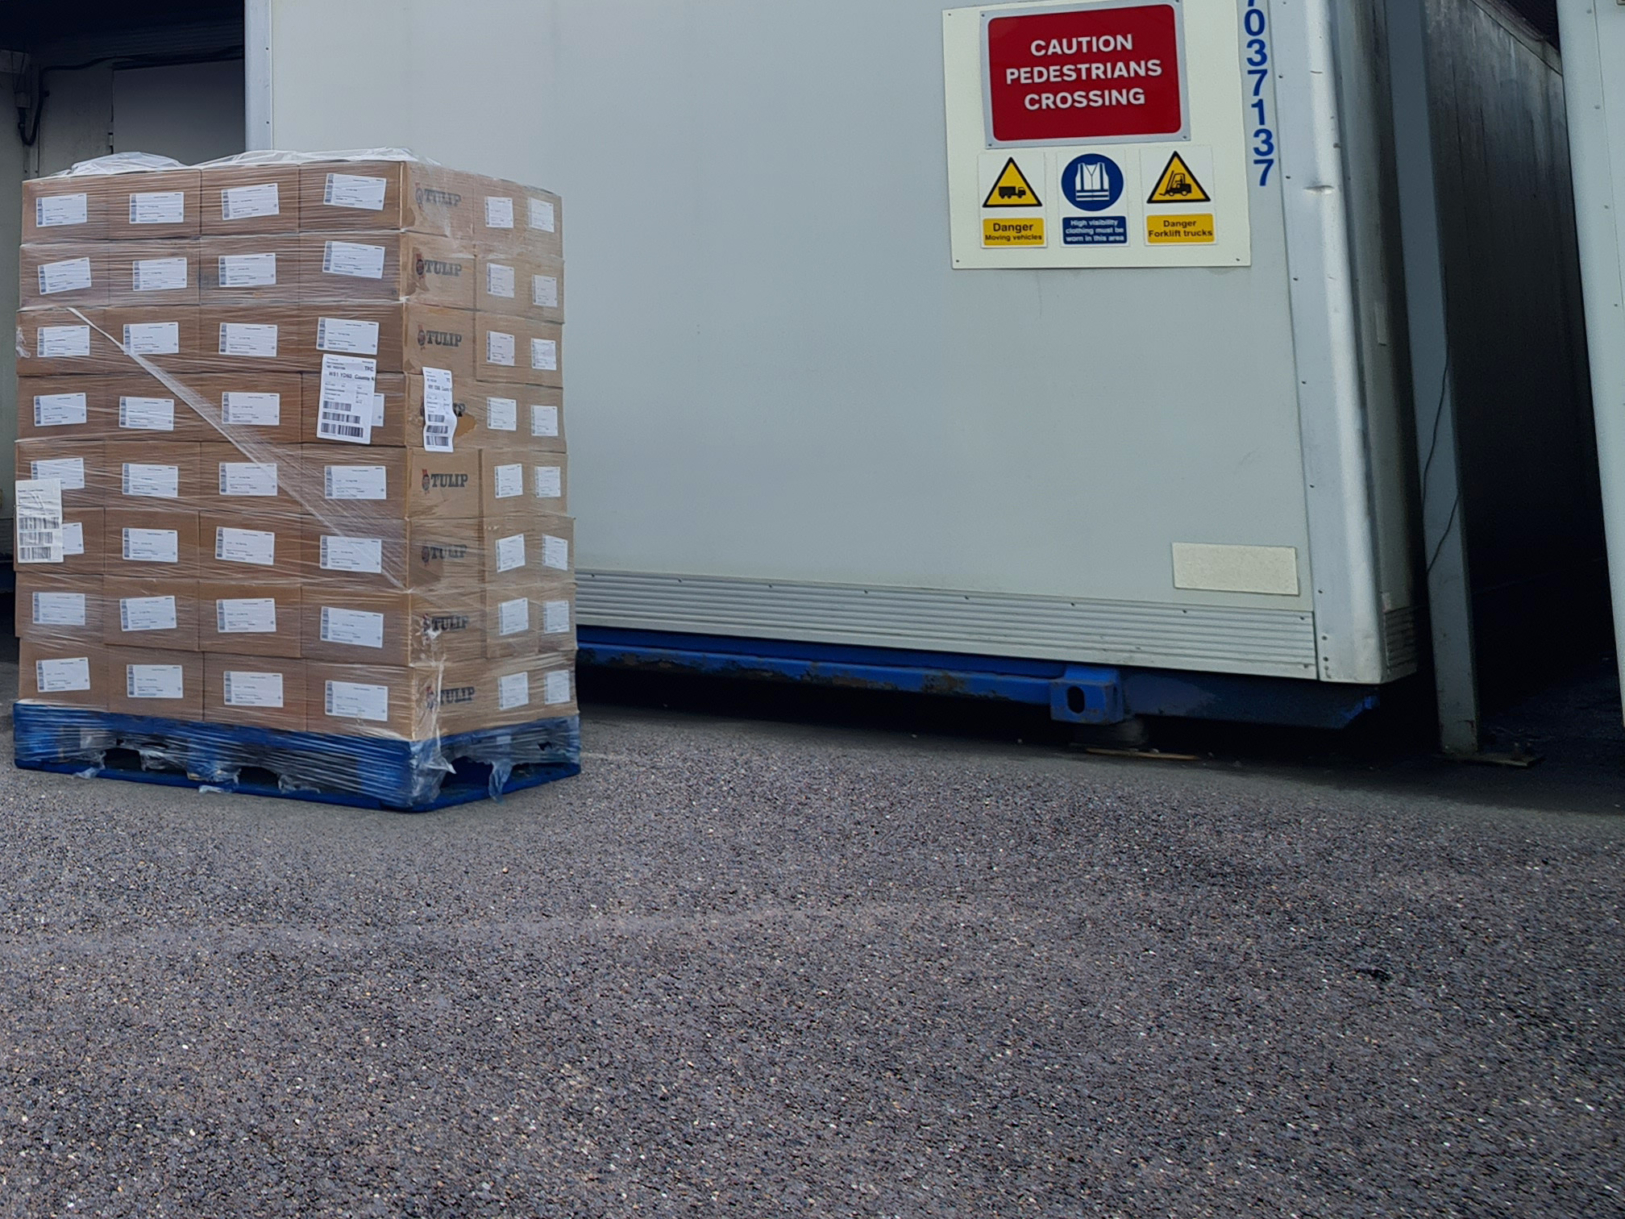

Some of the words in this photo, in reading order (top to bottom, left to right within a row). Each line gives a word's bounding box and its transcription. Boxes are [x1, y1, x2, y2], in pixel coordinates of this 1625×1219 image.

[1030, 33, 1133, 57] CAUTION
[1005, 58, 1163, 85] PEDESTRIANS
[1023, 87, 1145, 111] CROSSING
[424, 188, 462, 207] TULIP
[992, 222, 1034, 234] Danger
[1070, 219, 1088, 227] High
[1088, 218, 1119, 227] visibility
[1163, 219, 1197, 229] Danger
[985, 234, 1011, 242] Moving
[1013, 233, 1043, 241] vehicles
[1065, 227, 1094, 235] clothing
[1148, 229, 1181, 237] Forklift
[1183, 229, 1214, 237] trucks
[425, 259, 463, 277] TULIP
[426, 330, 463, 348] TULIP
[431, 473, 469, 488] TULIP
[431, 544, 467, 561] TULIP
[431, 615, 469, 631] TULIP
